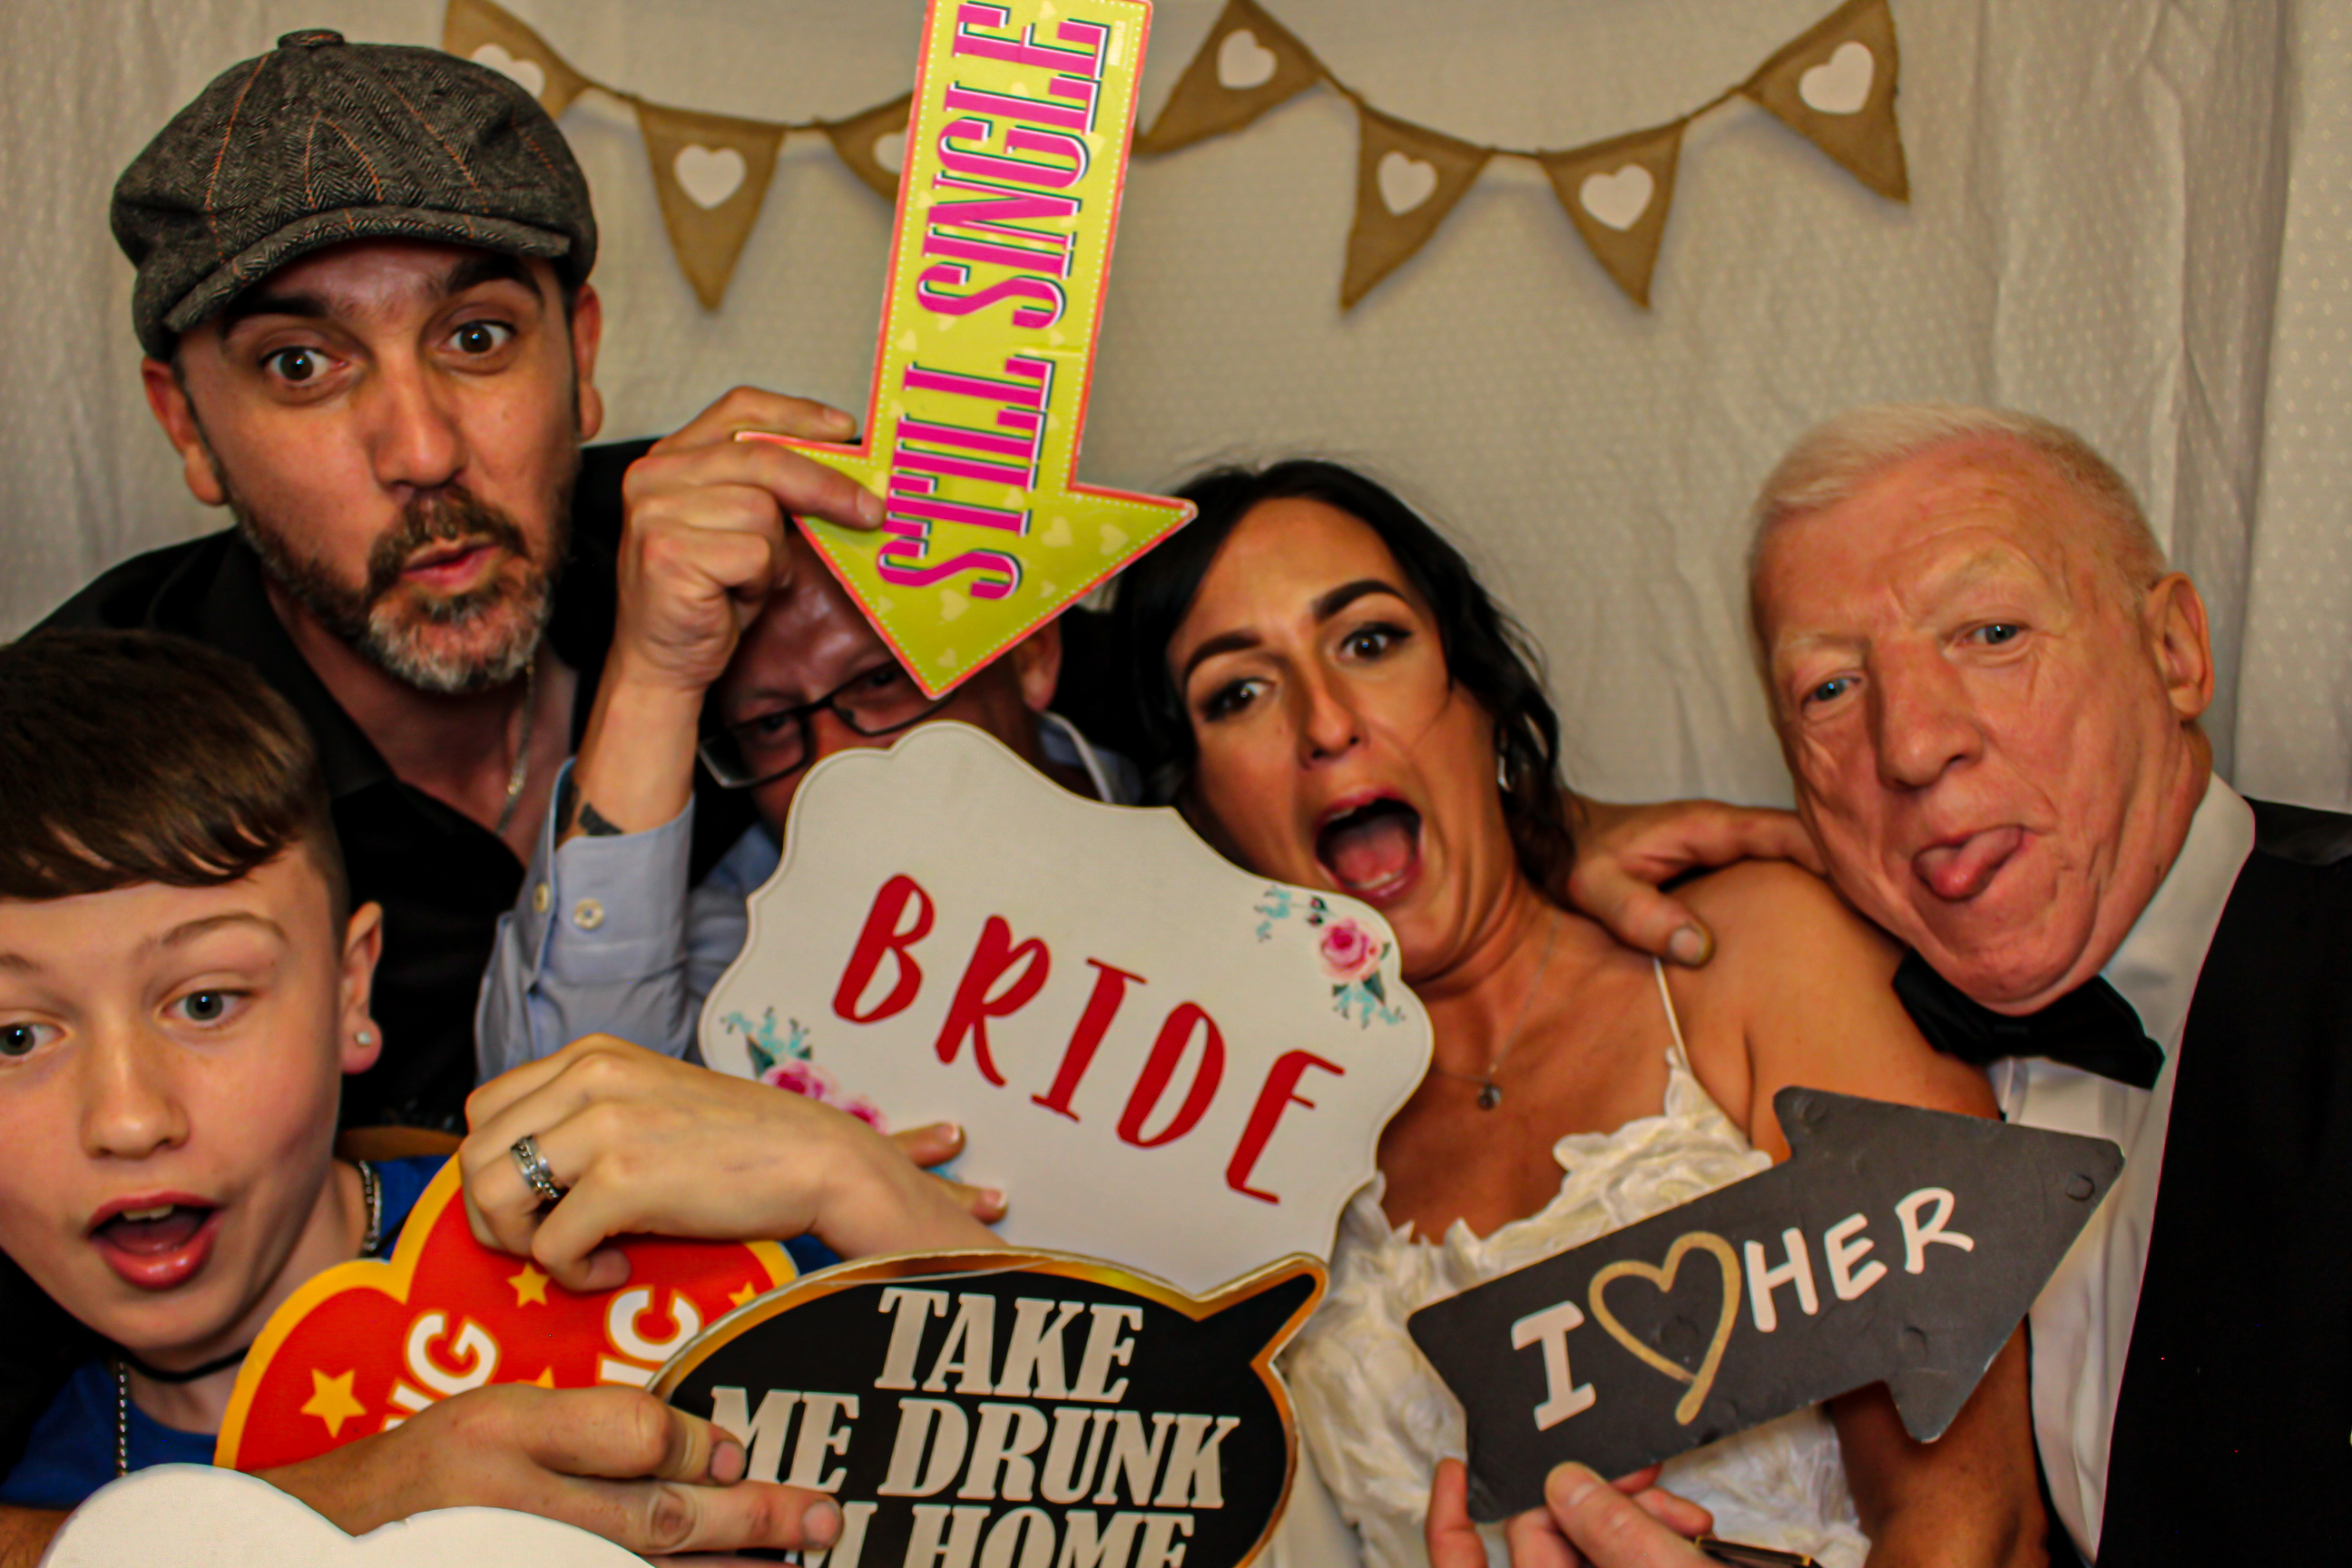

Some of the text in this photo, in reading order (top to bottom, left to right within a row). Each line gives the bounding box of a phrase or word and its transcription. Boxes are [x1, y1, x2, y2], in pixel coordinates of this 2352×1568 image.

[877, 1, 1112, 600] STILL SINGLE
[831, 874, 1345, 1205] BRIDE
[874, 1287, 1143, 1404] TAKE
[1511, 1187, 1975, 1431] I HER
[711, 1386, 1240, 1508] ME DRUNK
[903, 1504, 1195, 1568] HOME
